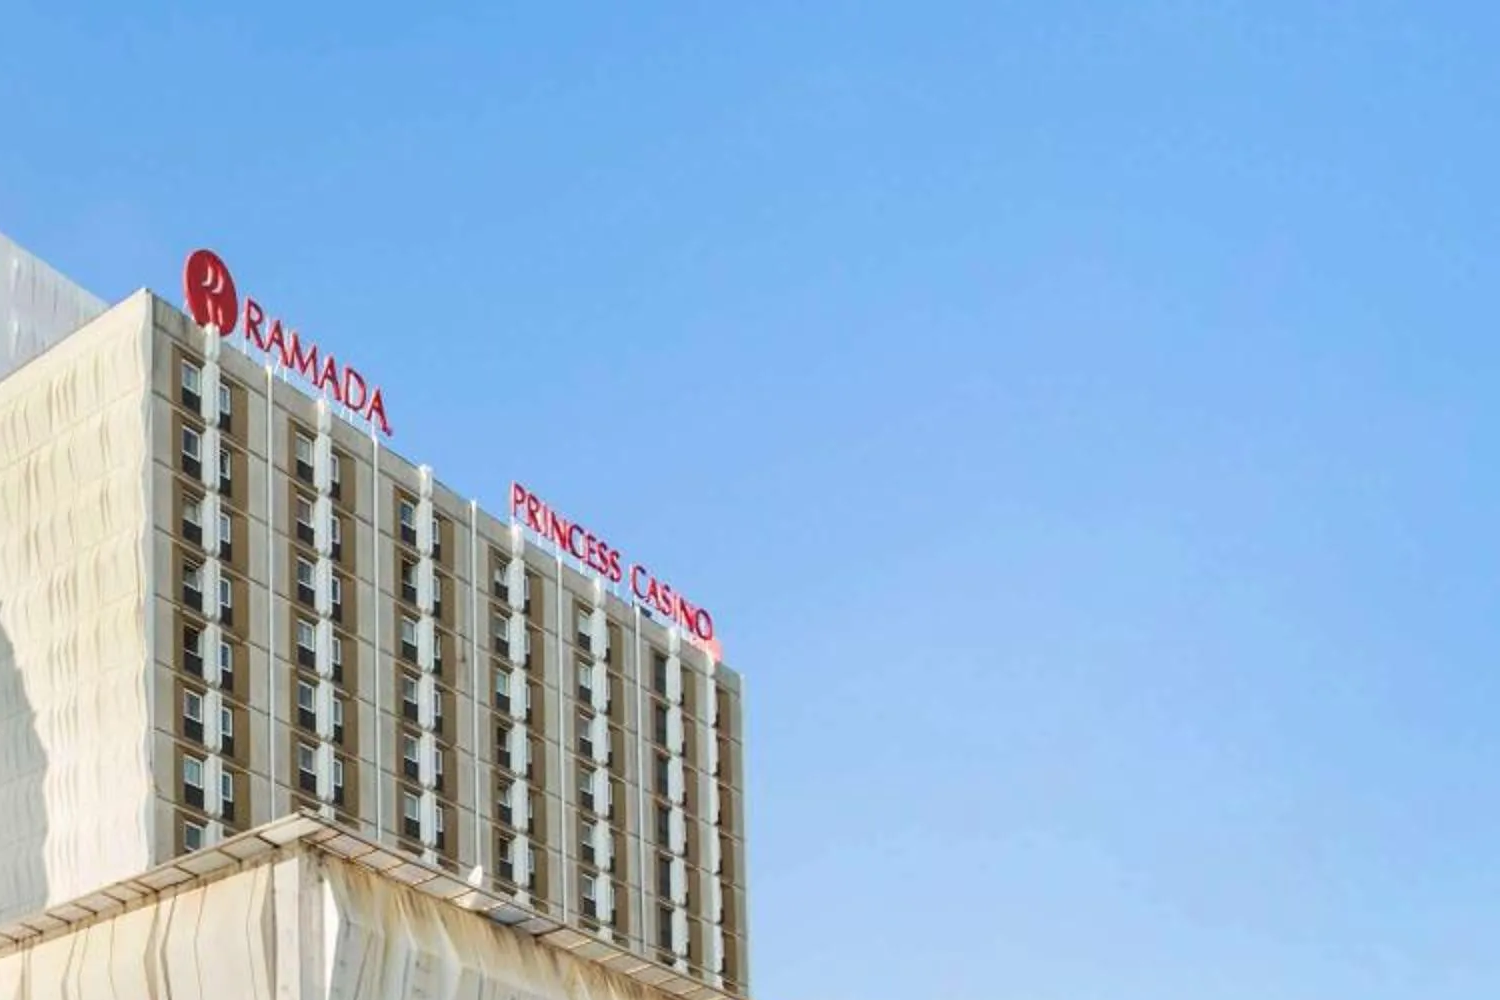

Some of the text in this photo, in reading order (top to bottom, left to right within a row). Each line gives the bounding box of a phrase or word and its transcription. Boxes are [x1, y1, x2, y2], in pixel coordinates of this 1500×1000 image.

[243, 297, 389, 435] RAMADA
[511, 481, 714, 642] PRINCESS CASINO
